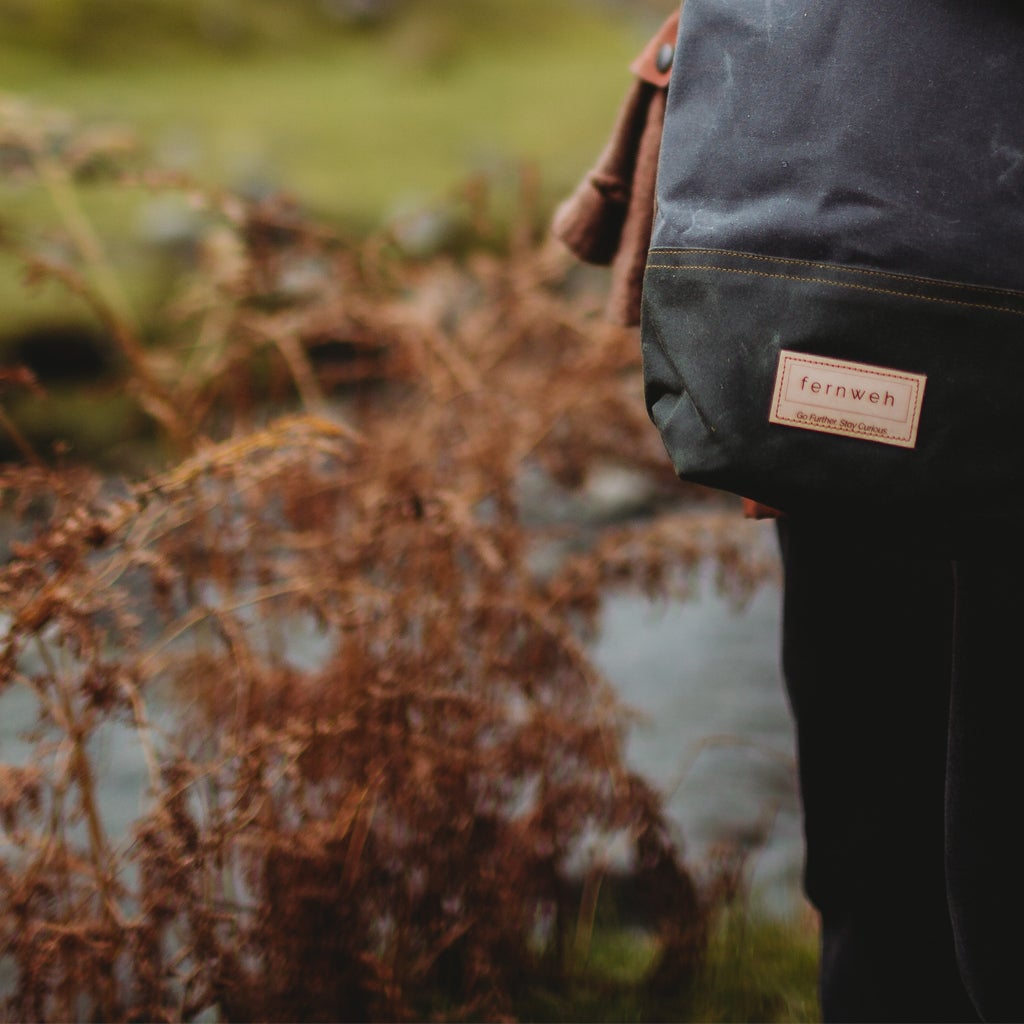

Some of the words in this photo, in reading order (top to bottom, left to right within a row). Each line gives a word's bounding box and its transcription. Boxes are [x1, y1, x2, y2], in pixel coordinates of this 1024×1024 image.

[800, 376, 895, 407] fernweh
[796, 411, 808, 420] Go
[840, 418, 857, 429] Stay
